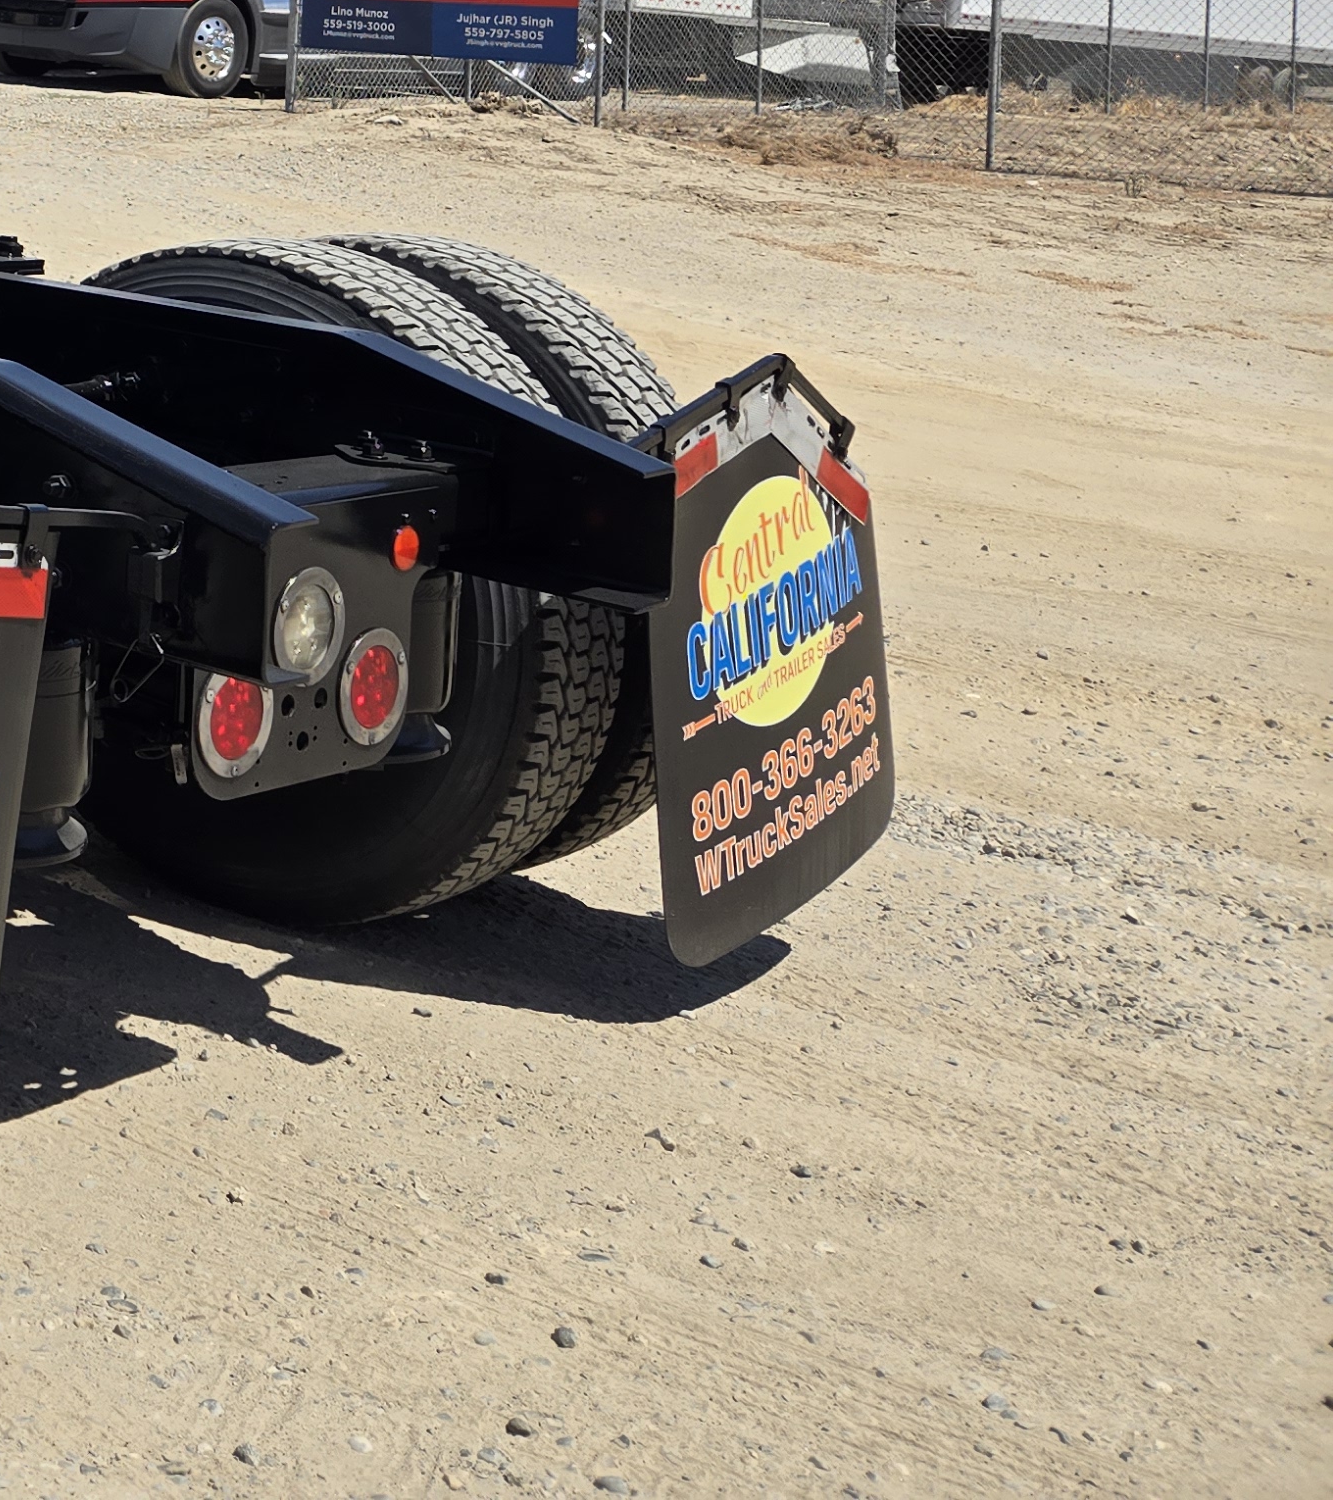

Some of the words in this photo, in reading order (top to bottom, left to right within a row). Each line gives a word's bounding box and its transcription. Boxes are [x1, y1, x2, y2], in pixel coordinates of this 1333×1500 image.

[323, 19, 395, 32] 559-519-3000
[331, 6, 353, 17] Lino
[355, 7, 389, 19] Munoz
[456, 13, 491, 25] Jujhar
[493, 15, 518, 26] (JR)
[521, 16, 554, 29] Singh
[464, 27, 545, 41] 559-797-5805
[699, 464, 815, 617] Central
[687, 525, 863, 701] CALIFORNIA
[714, 688, 754, 725] TRUCK
[757, 668, 774, 700] and
[773, 647, 816, 690] TRAILER
[816, 623, 847, 658] SALES
[691, 674, 877, 843] 800-366-3263
[694, 734, 881, 897] WTruckSales.net
